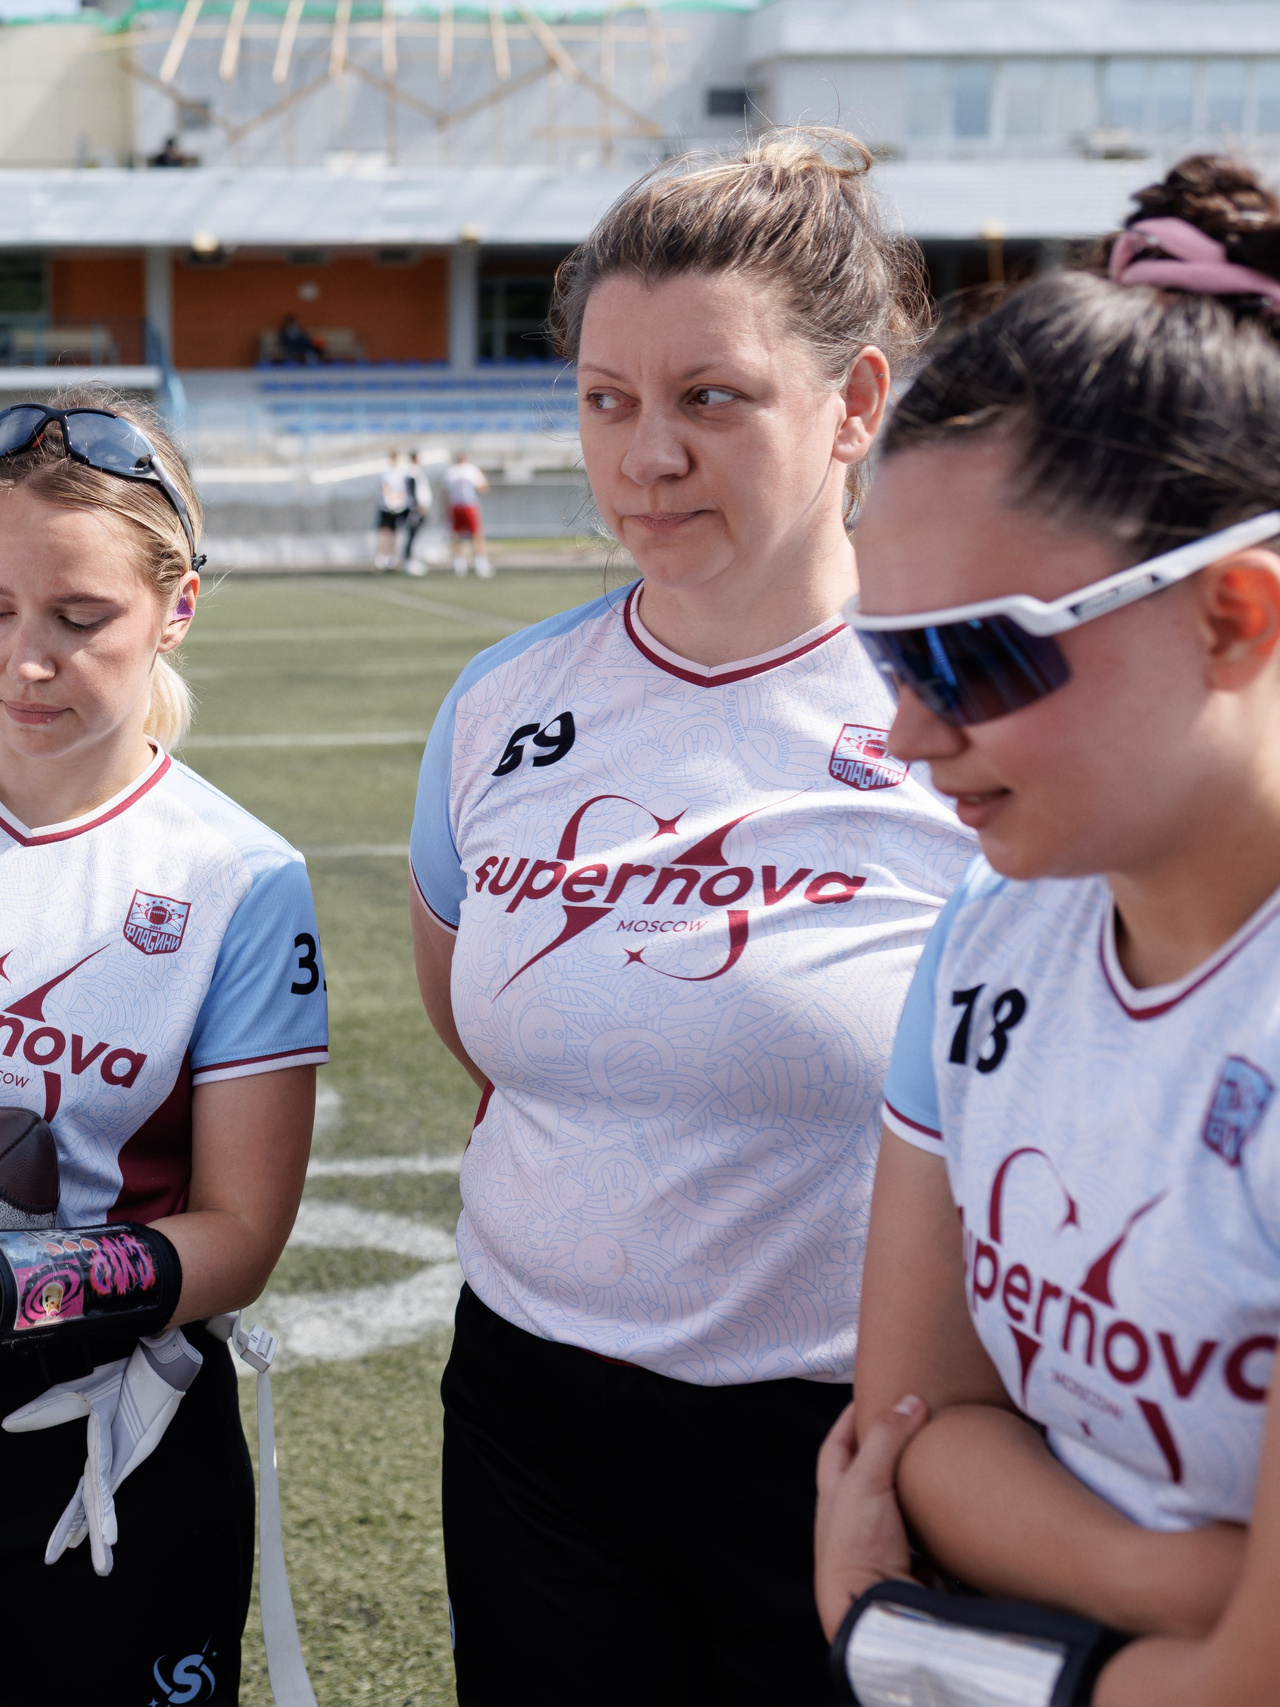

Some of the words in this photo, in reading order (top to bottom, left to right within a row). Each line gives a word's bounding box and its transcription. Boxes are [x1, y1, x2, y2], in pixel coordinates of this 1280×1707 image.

[475, 855, 867, 913] supernova
[615, 918, 708, 933] MOSCOW
[291, 932, 327, 996] 3
[963, 1232, 1280, 1405] pernova
